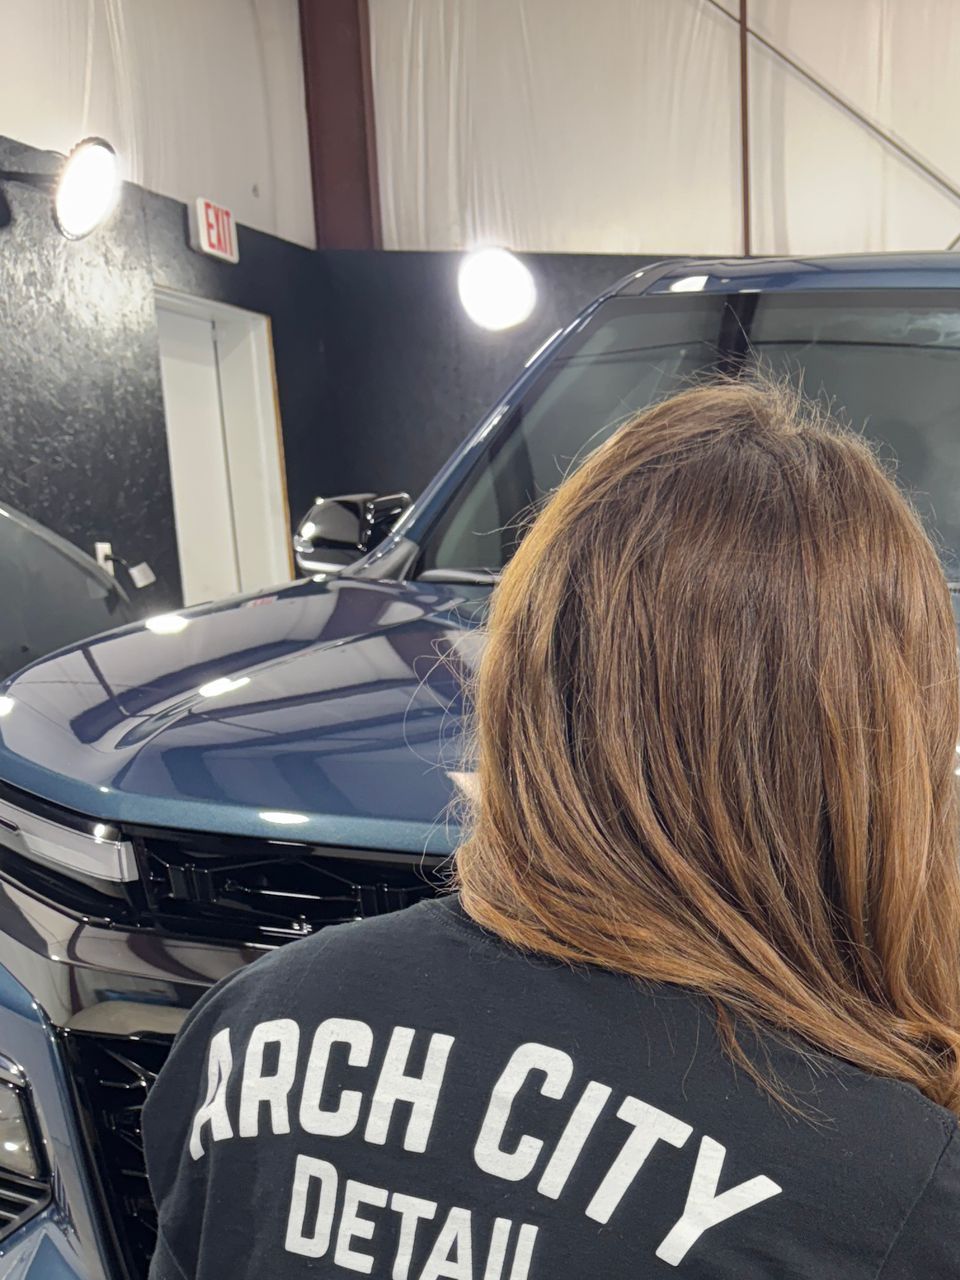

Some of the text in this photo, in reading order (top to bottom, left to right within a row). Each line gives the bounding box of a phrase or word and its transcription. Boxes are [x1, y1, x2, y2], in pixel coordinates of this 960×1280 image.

[203, 201, 234, 257] EXIT
[189, 1018, 782, 1266] ARCH CITY
